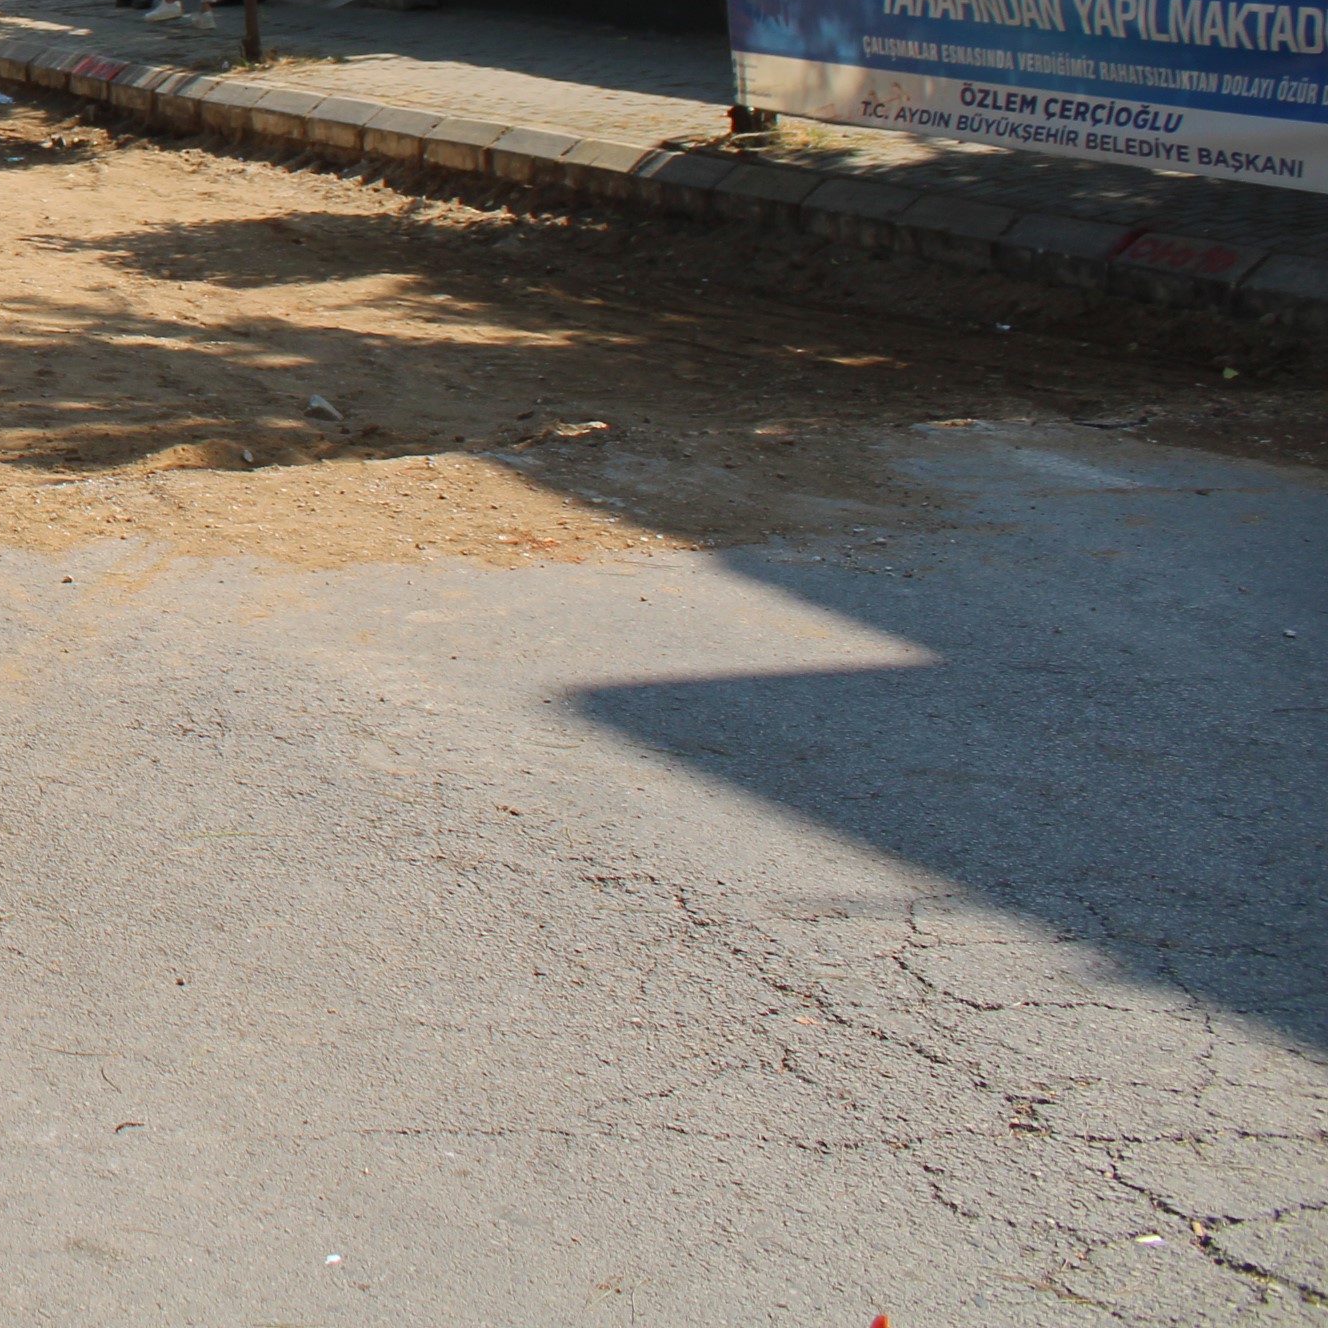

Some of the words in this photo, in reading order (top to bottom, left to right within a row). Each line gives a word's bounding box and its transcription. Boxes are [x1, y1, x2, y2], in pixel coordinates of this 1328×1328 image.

[863, 35, 938, 61] ÇALIŞMALAR
[942, 43, 1014, 70] ESNASINDA
[1017, 50, 1096, 79] VERDİĞİMİZ
[1099, 61, 1219, 93] RAHATSIZLIKTAN
[1221, 74, 1275, 100] DOLAYI
[1277, 75, 1318, 104] ÖZÜR
[861, 100, 888, 120] T.C.
[894, 106, 952, 129] AYDIN
[956, 112, 1079, 148] BÜYÜKŞEHİR
[1085, 132, 1190, 162] BELEDİYE
[1197, 147, 1304, 178] BAŞKANI
[960, 83, 1038, 115] ÖZLEM
[1043, 97, 1184, 133] ÇERÇİOĞLU
